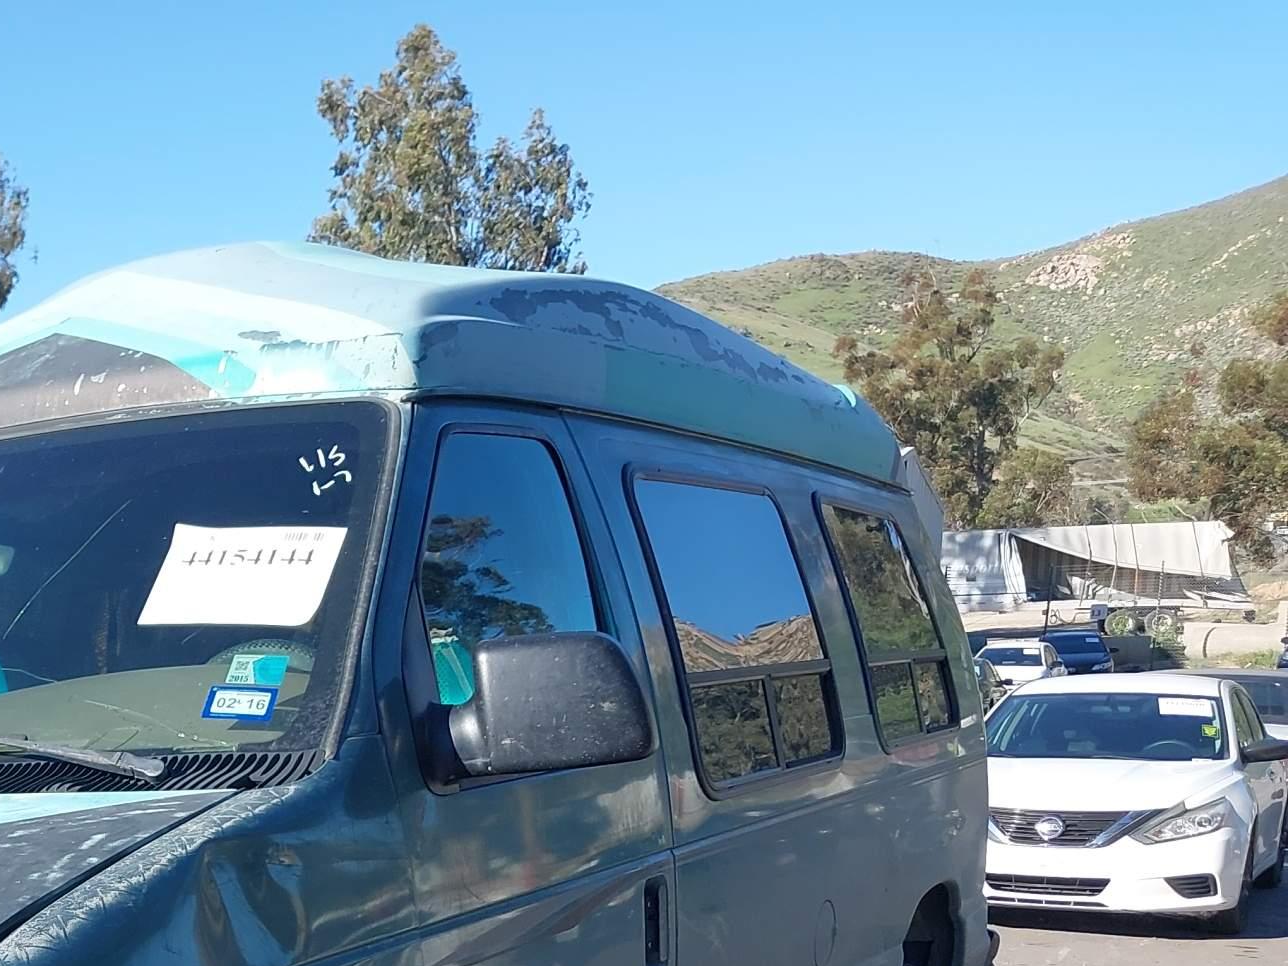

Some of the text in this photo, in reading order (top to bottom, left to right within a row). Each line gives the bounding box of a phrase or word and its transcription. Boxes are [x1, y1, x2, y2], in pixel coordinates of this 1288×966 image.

[182, 548, 314, 566] 44154144
[228, 674, 249, 682] 2015
[216, 697, 266, 710] 02 16
